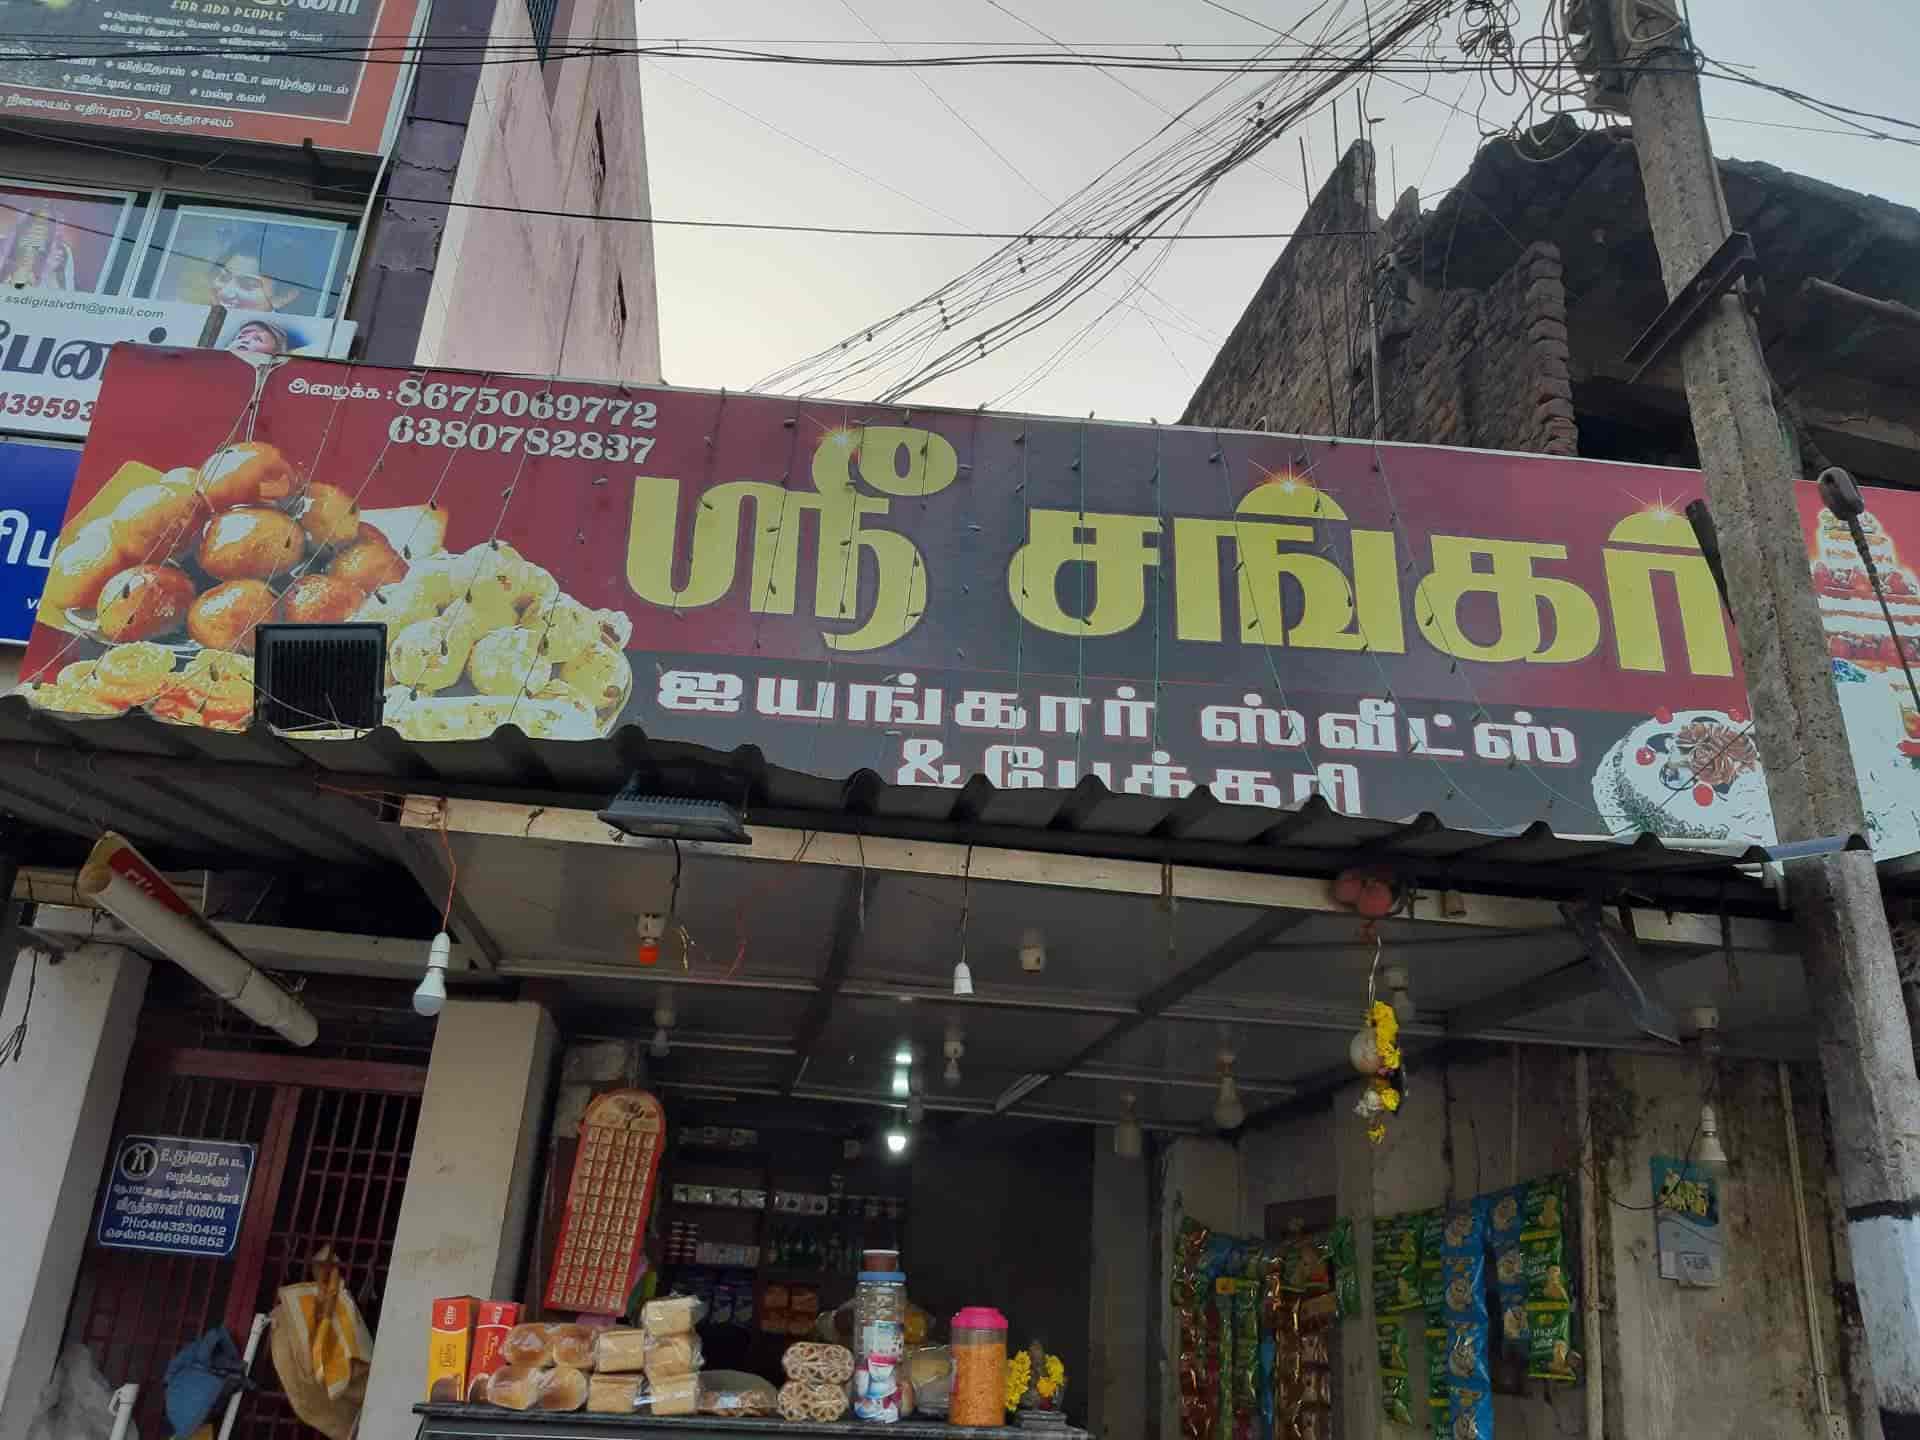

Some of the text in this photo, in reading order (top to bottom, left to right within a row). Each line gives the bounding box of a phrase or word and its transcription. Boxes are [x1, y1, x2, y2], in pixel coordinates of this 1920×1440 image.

[5, 295, 165, 320] ssdigitalvdm@gmail.com
[388, 416, 657, 465] 6380782837
[657, 669, 1577, 764] ஐயங்கார் ஸ்வீட்ஸ்
